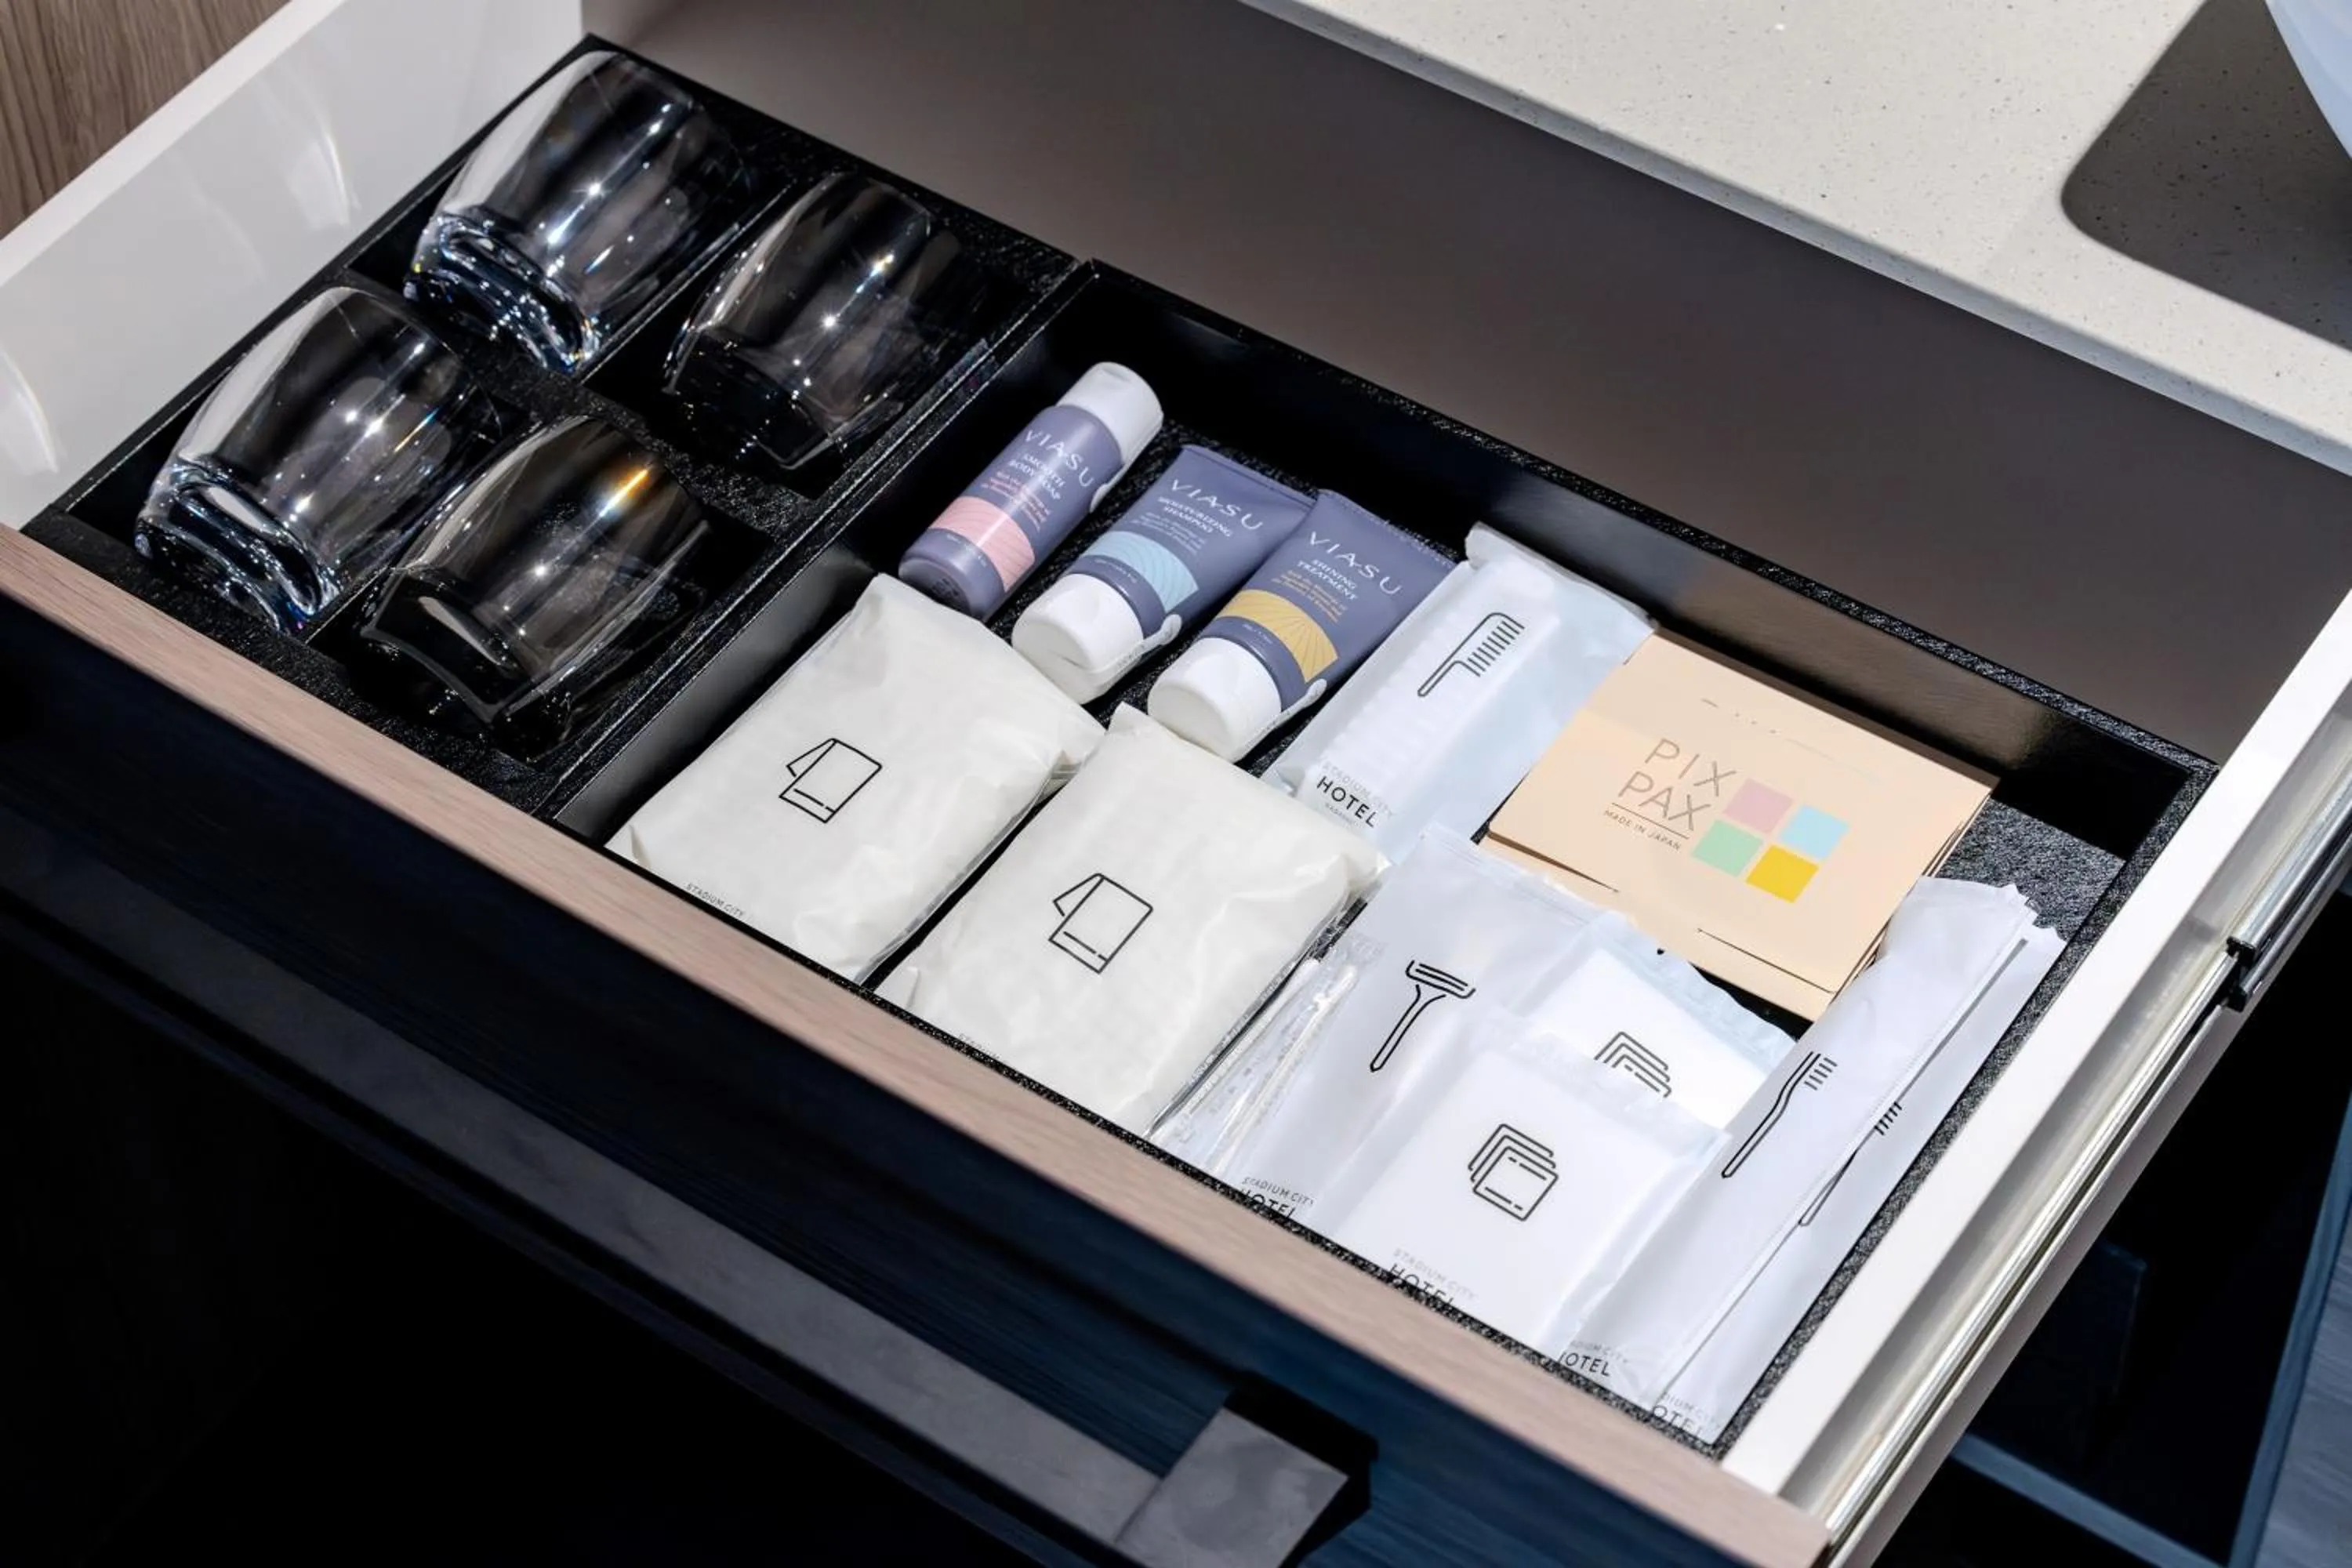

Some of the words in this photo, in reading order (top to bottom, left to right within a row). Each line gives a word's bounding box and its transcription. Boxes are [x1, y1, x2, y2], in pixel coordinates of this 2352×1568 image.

[1025, 430, 1094, 488] VIASU
[1171, 479, 1264, 531] VIASU
[1298, 560, 1358, 601] TREATMENT
[1308, 531, 1403, 595] VIASU
[1643, 737, 1737, 797] PIX
[1317, 775, 1377, 829] HOTEL
[1617, 770, 1711, 832] PAX
[1604, 810, 1632, 828] MADE
[1634, 823, 1647, 834] IN
[1646, 830, 1682, 851] JAPAN
[685, 882, 724, 908] STADIUM
[1242, 1177, 1290, 1196] STADIUM
